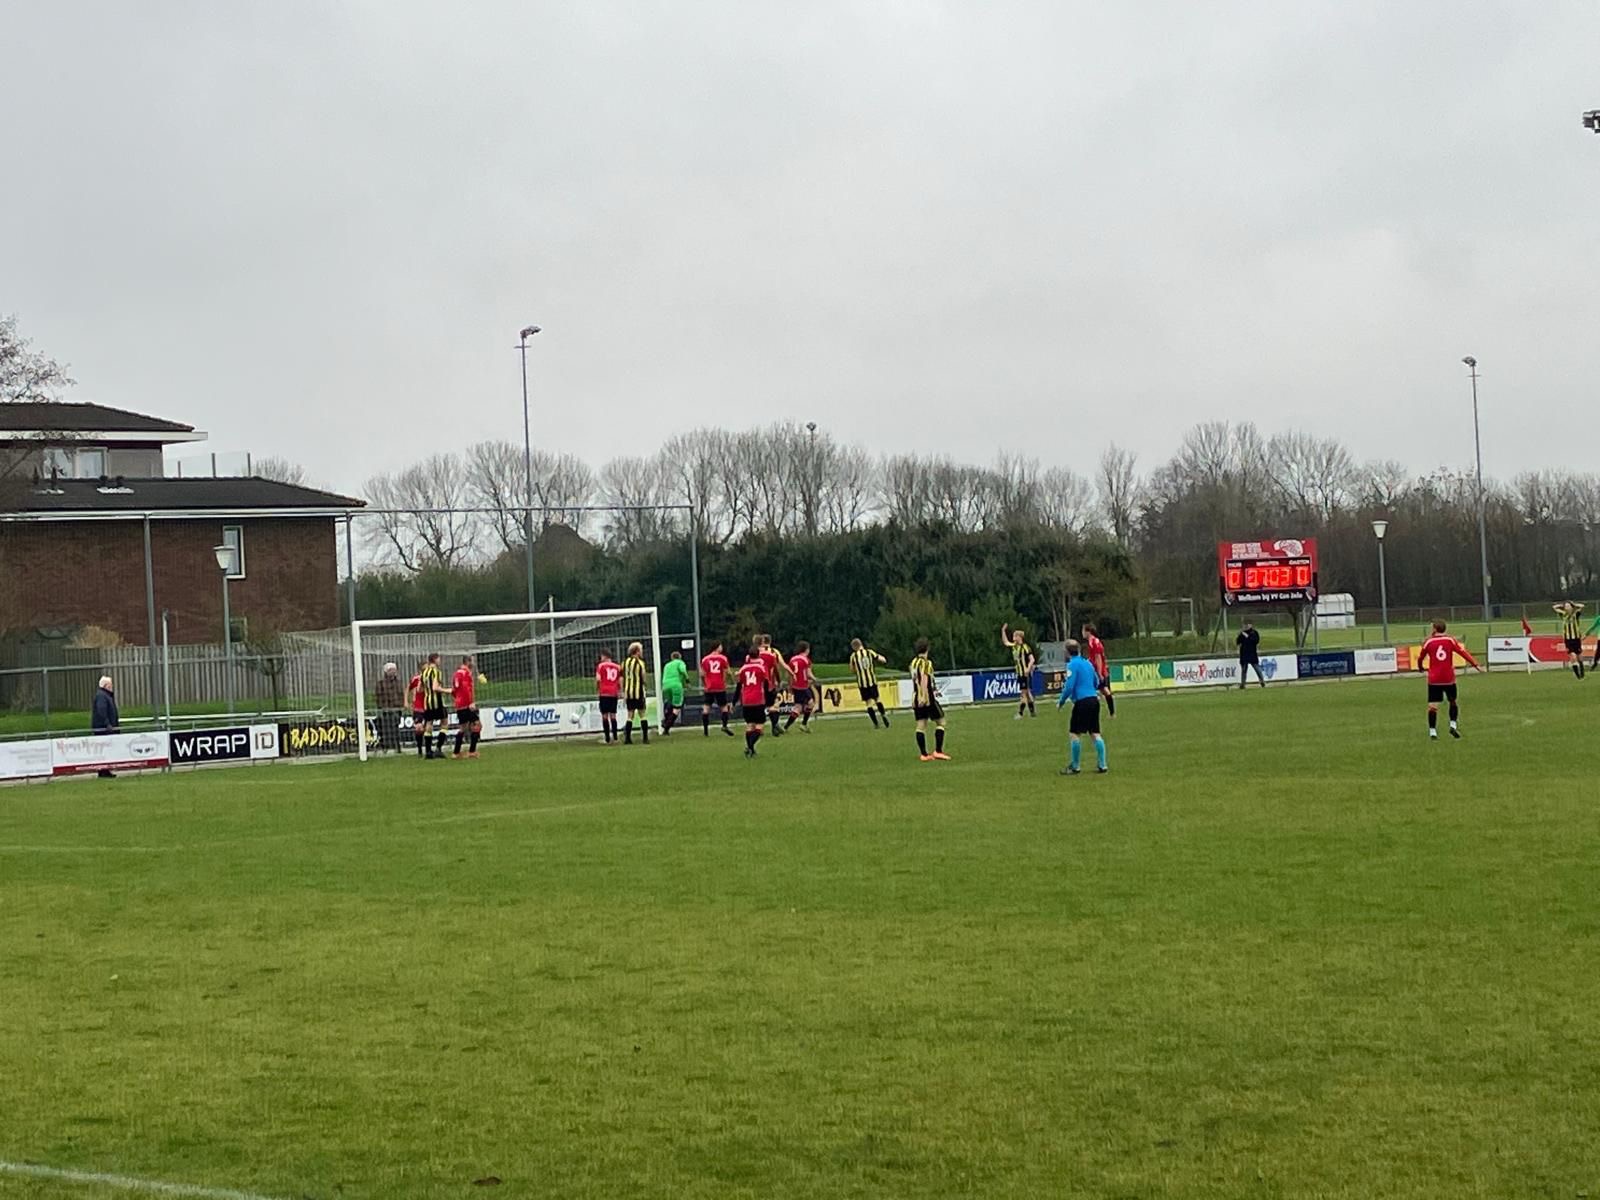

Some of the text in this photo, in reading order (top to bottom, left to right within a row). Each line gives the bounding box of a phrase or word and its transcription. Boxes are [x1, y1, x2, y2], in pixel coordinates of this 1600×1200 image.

[1436, 645, 1447, 661] 6
[605, 667, 617, 680] 10
[708, 660, 720, 673] 12
[1123, 663, 1161, 681] PRONK
[745, 671, 757, 686] 14
[174, 731, 274, 757] WRAP ID
